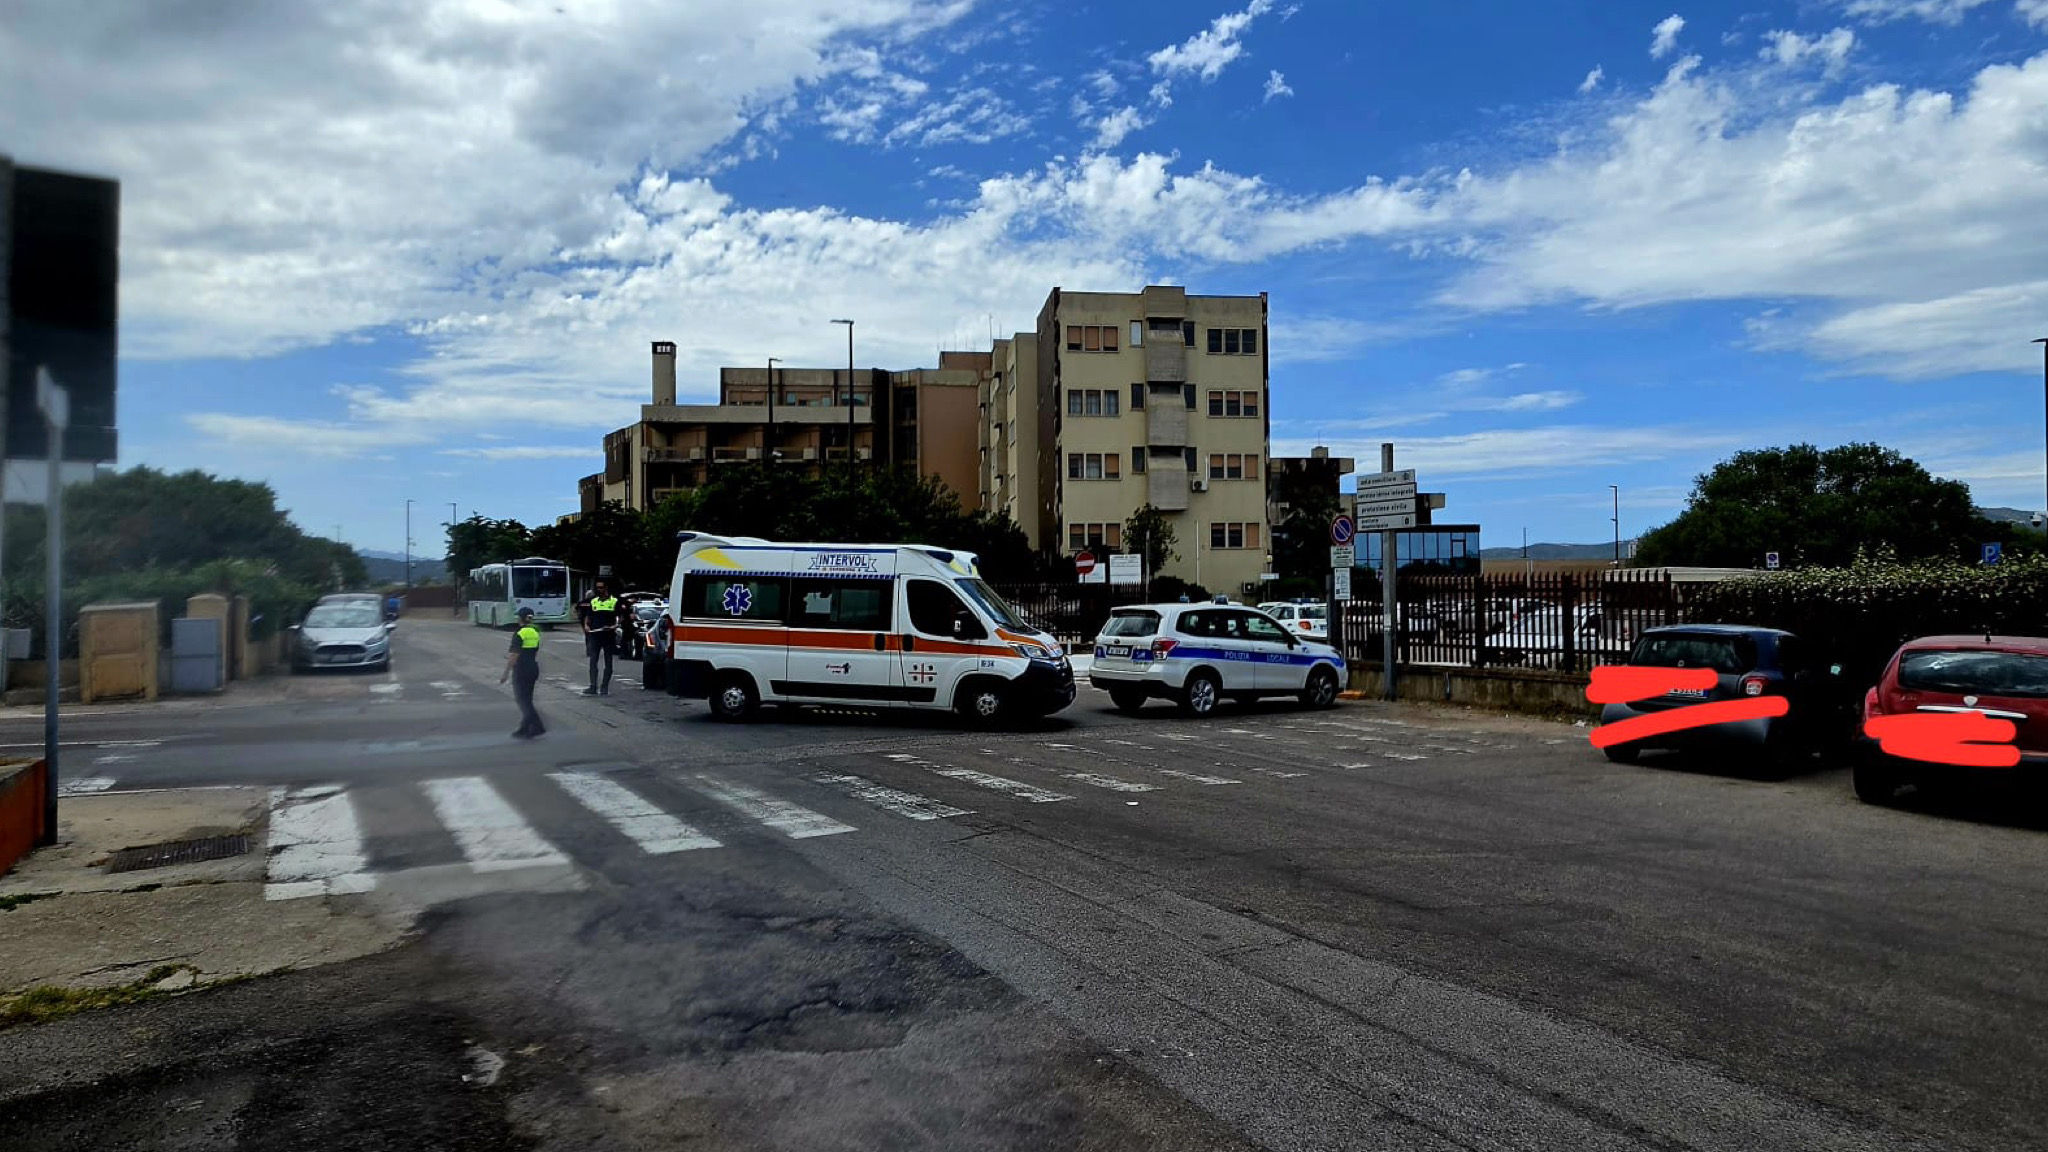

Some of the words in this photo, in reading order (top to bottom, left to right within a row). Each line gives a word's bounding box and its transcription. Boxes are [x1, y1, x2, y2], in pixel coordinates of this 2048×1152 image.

[1985, 545, 1996, 562] P
[819, 554, 868, 567] INTERVOL
[1224, 651, 1250, 660] POLIZIA
